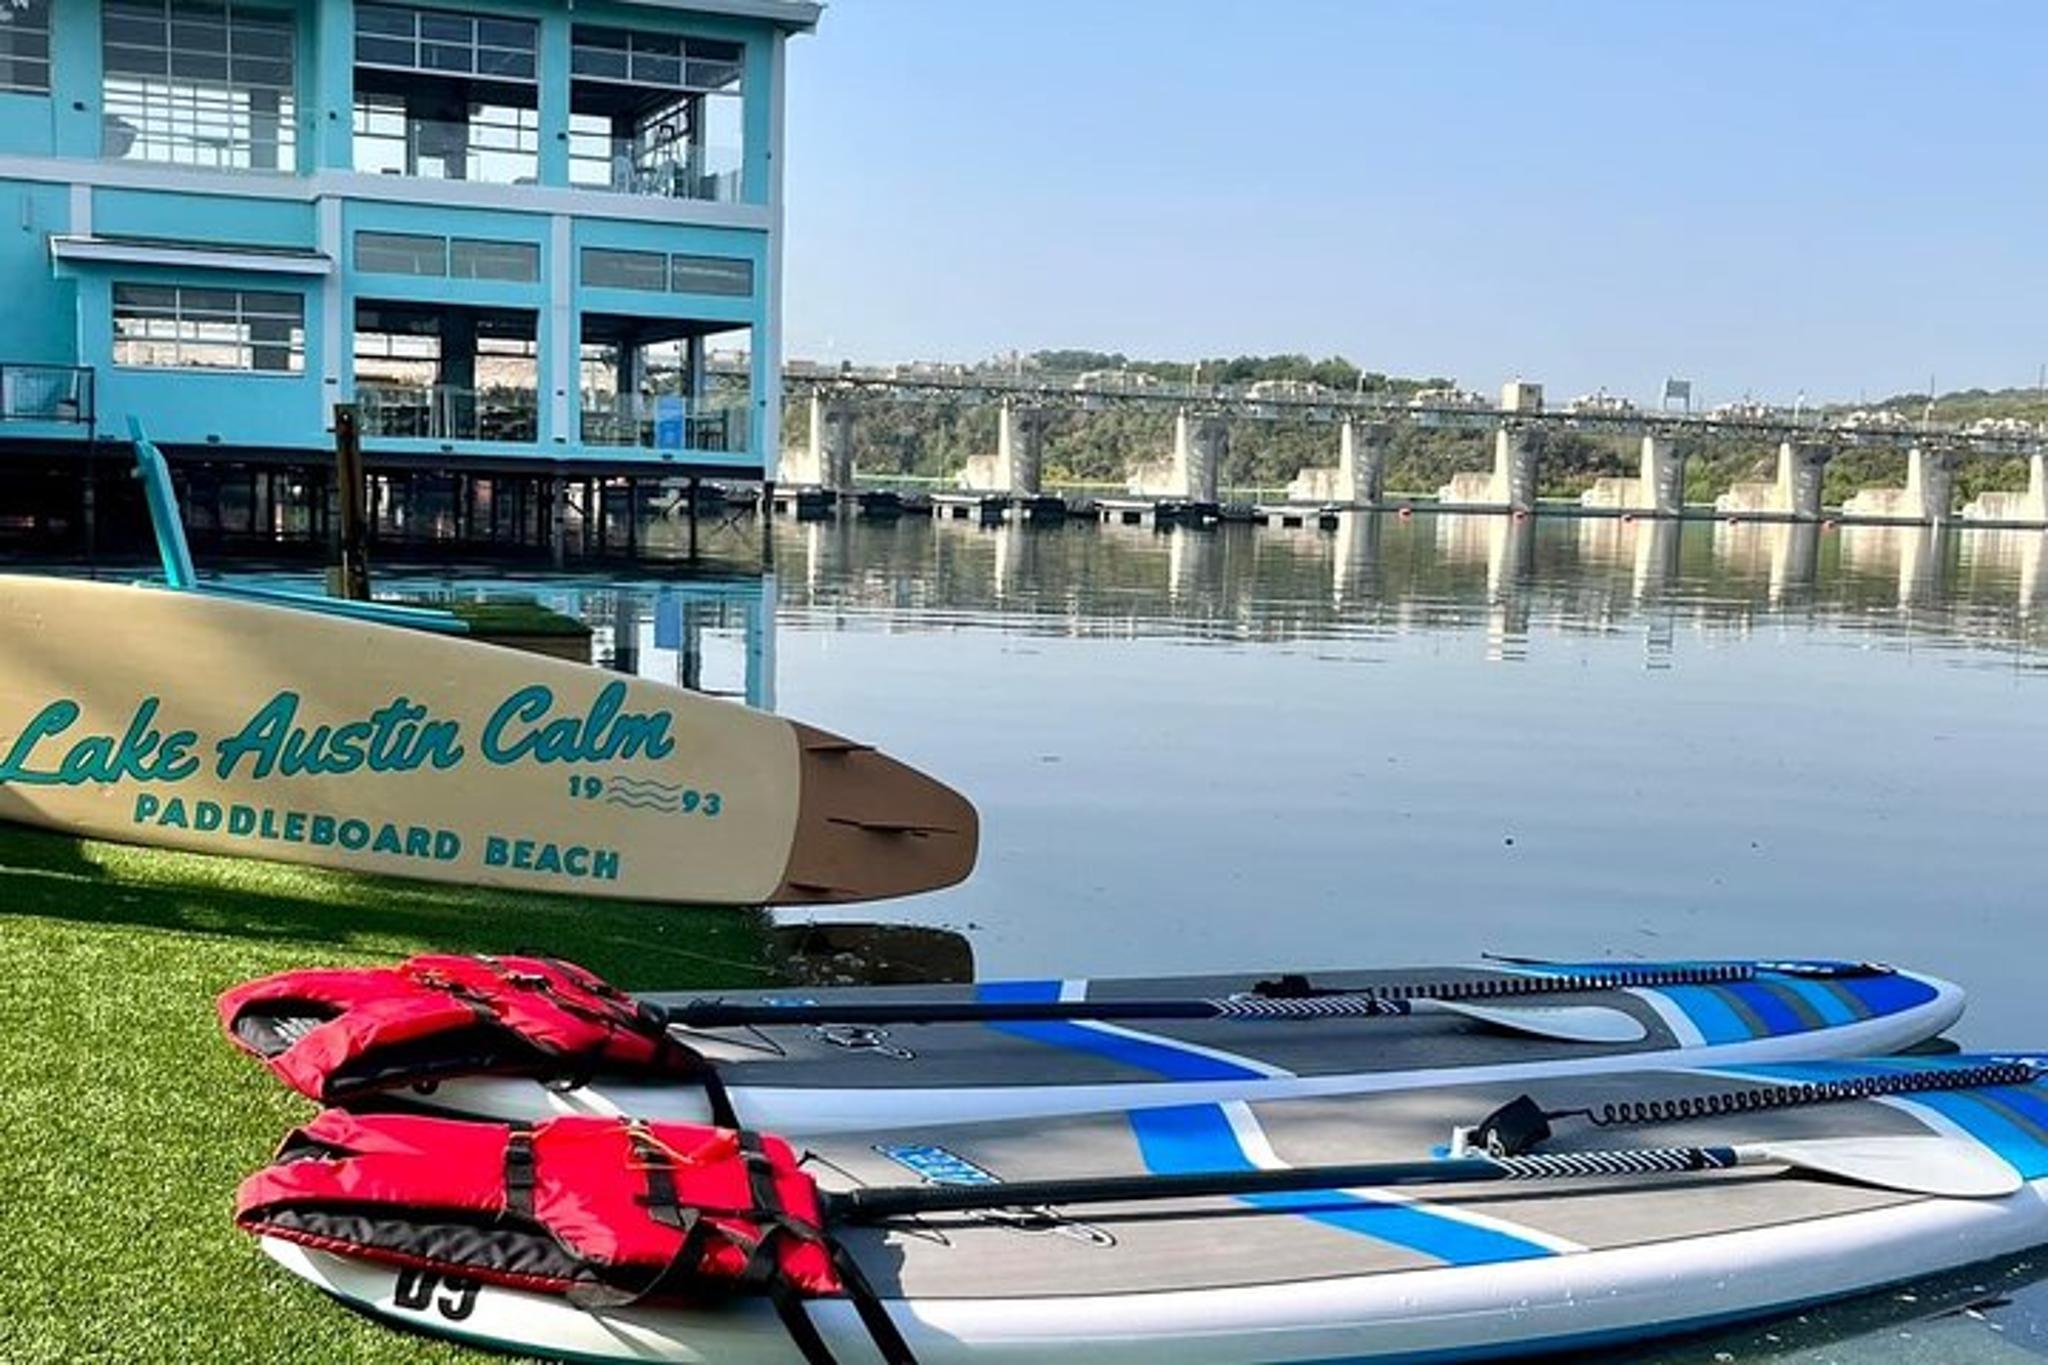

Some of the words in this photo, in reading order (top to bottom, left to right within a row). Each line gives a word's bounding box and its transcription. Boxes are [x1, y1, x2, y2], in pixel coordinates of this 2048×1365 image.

[0, 697, 199, 785] Lake
[217, 692, 463, 779] Austin
[481, 680, 675, 766] Calm
[134, 793, 461, 862] PADDLEBOARD
[484, 836, 620, 881] BEACH
[568, 775, 602, 799] 19
[683, 789, 721, 817] 93
